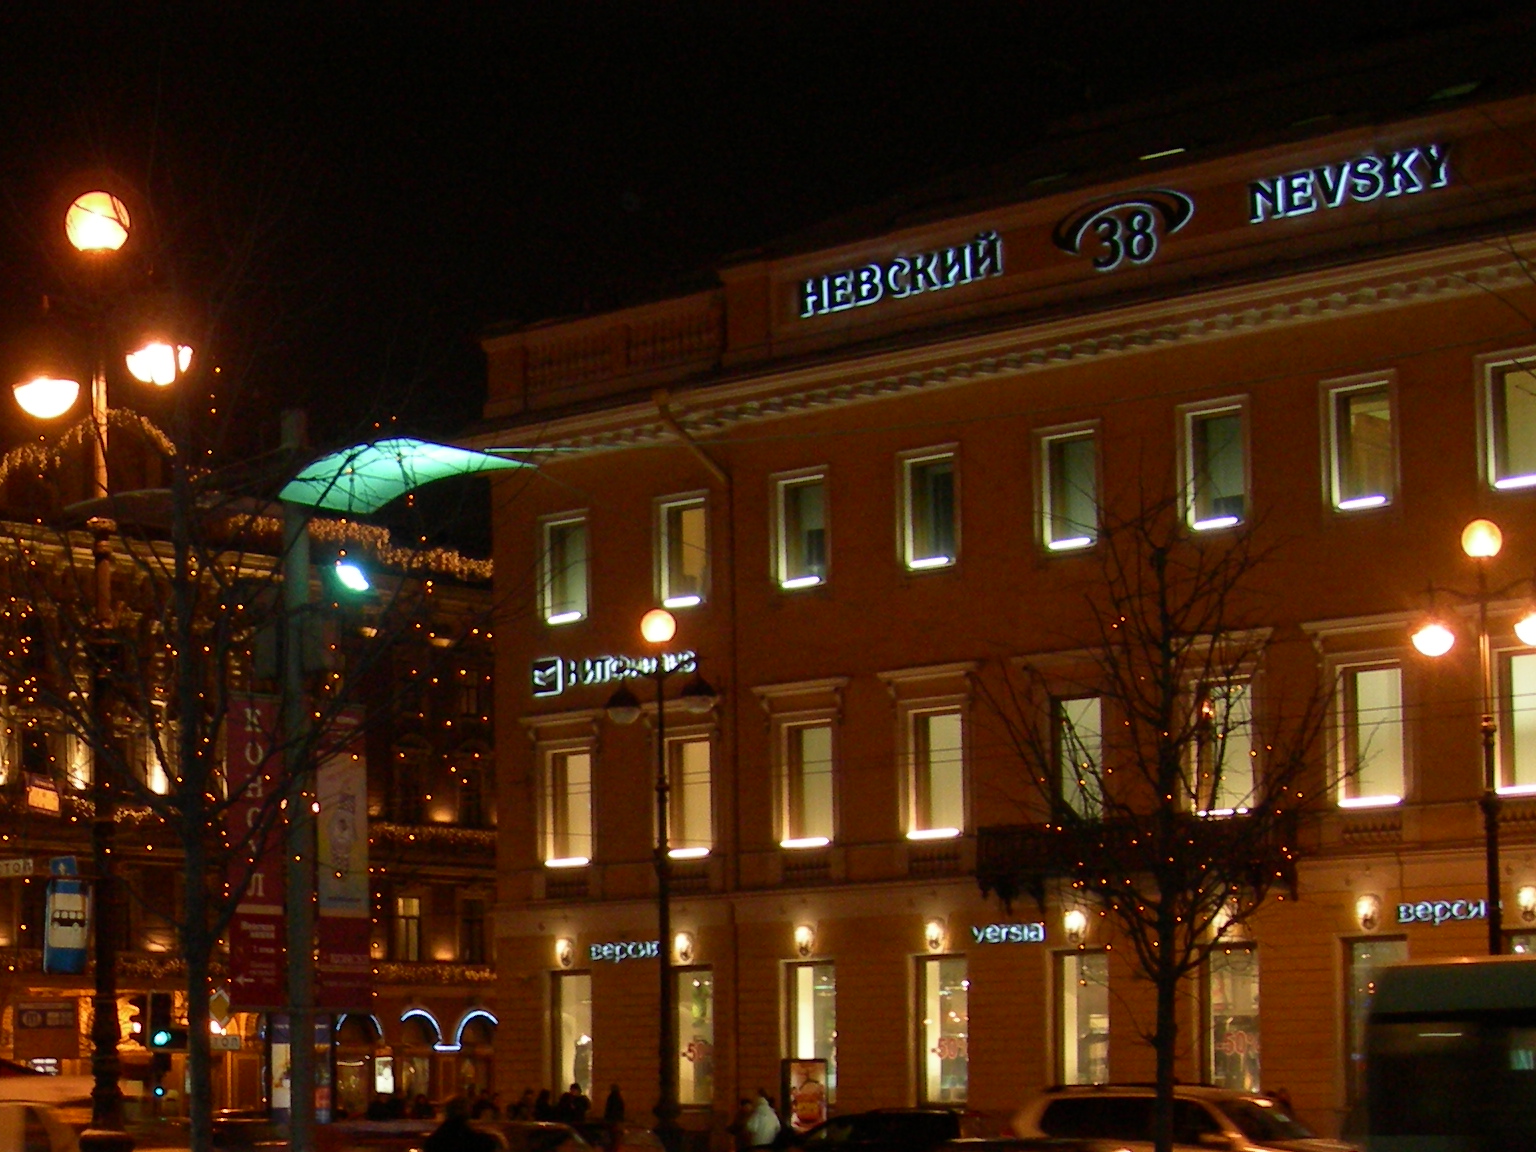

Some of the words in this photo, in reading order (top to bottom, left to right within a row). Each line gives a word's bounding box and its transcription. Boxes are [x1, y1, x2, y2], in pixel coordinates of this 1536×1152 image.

[1247, 143, 1455, 225] NEVSKY
[1090, 207, 1159, 272] 38
[798, 230, 1005, 318] НЕВСКИЙ
[971, 922, 1044, 944] versia
[1397, 899, 1503, 926] верси
